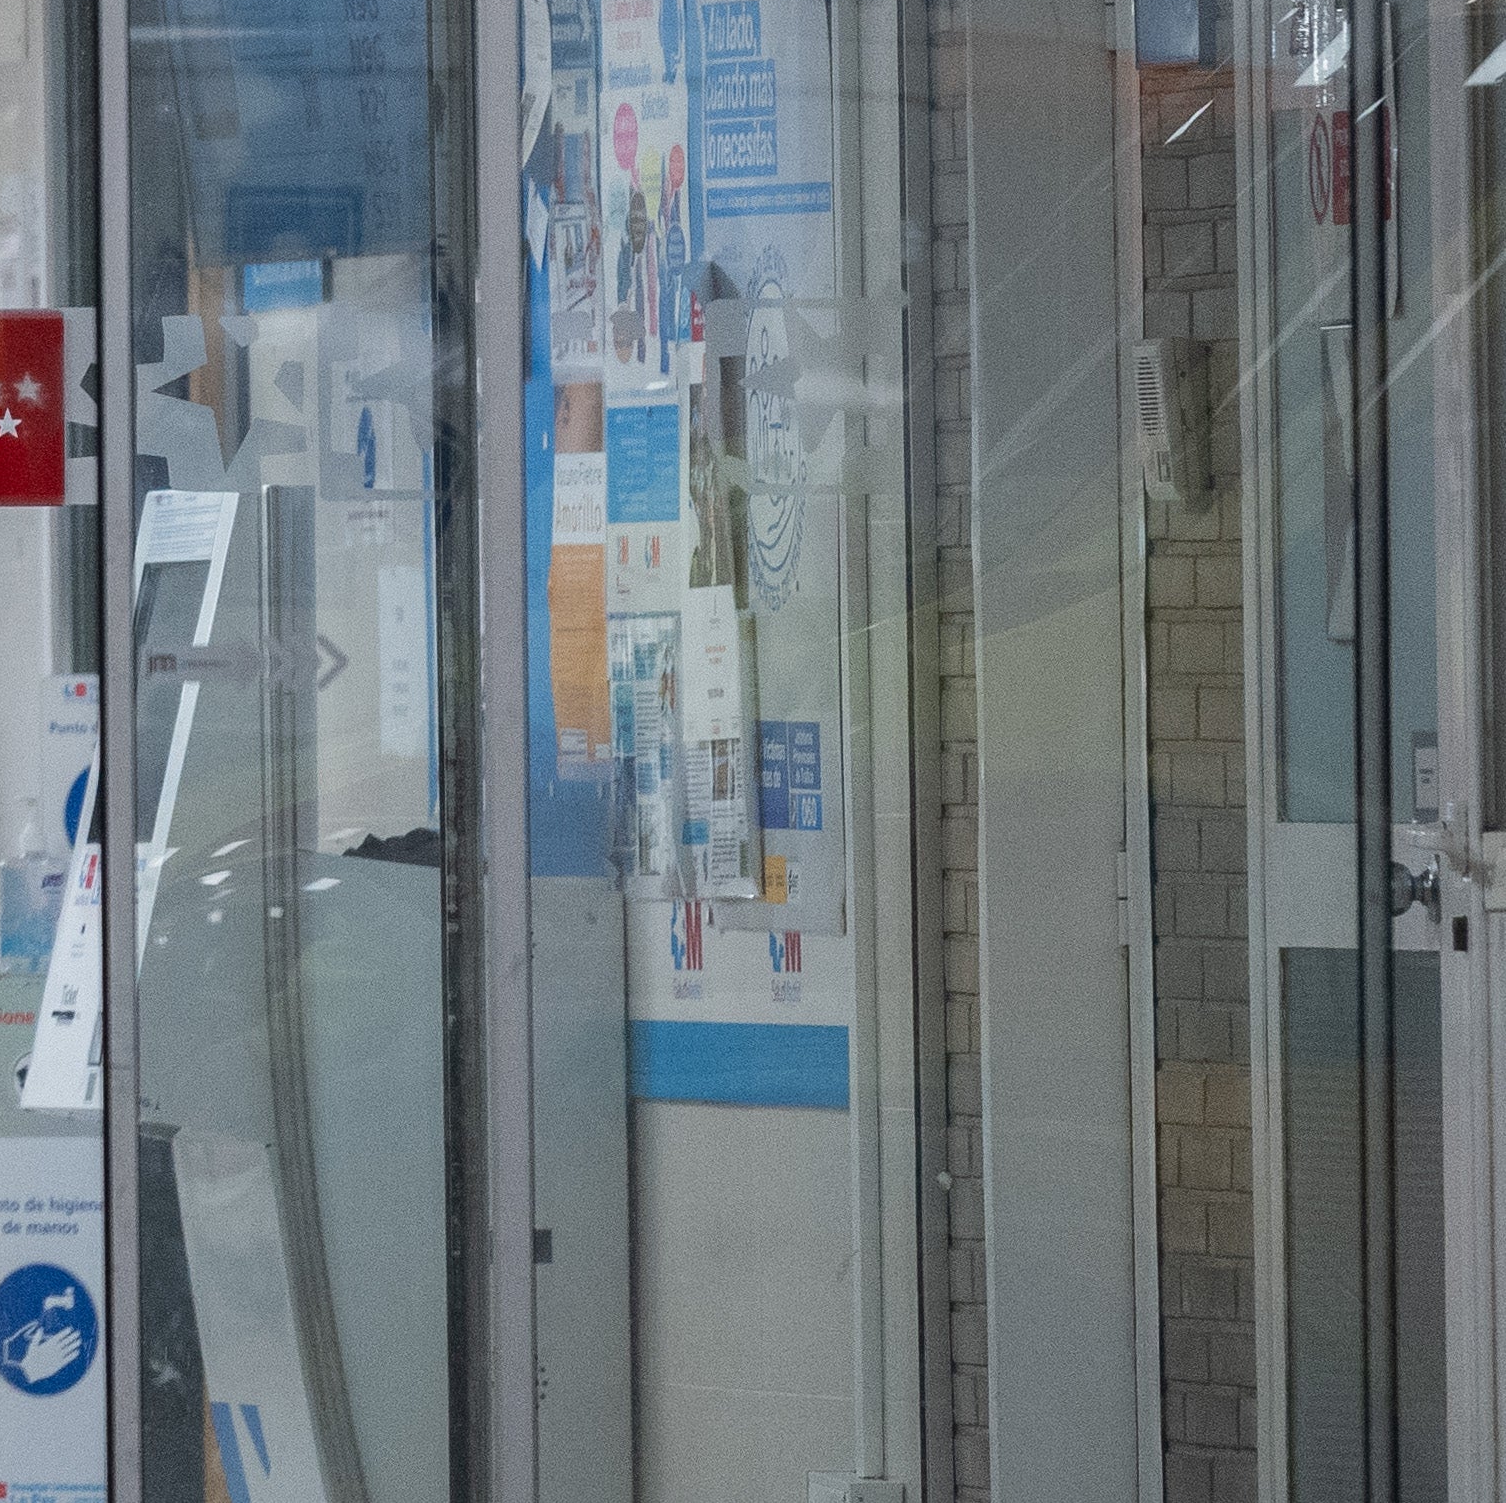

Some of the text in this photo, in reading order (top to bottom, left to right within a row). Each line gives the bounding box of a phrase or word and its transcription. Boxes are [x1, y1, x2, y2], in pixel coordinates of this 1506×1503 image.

[24, 1196, 45, 1212] de
[2, 1219, 80, 1235] de manos
